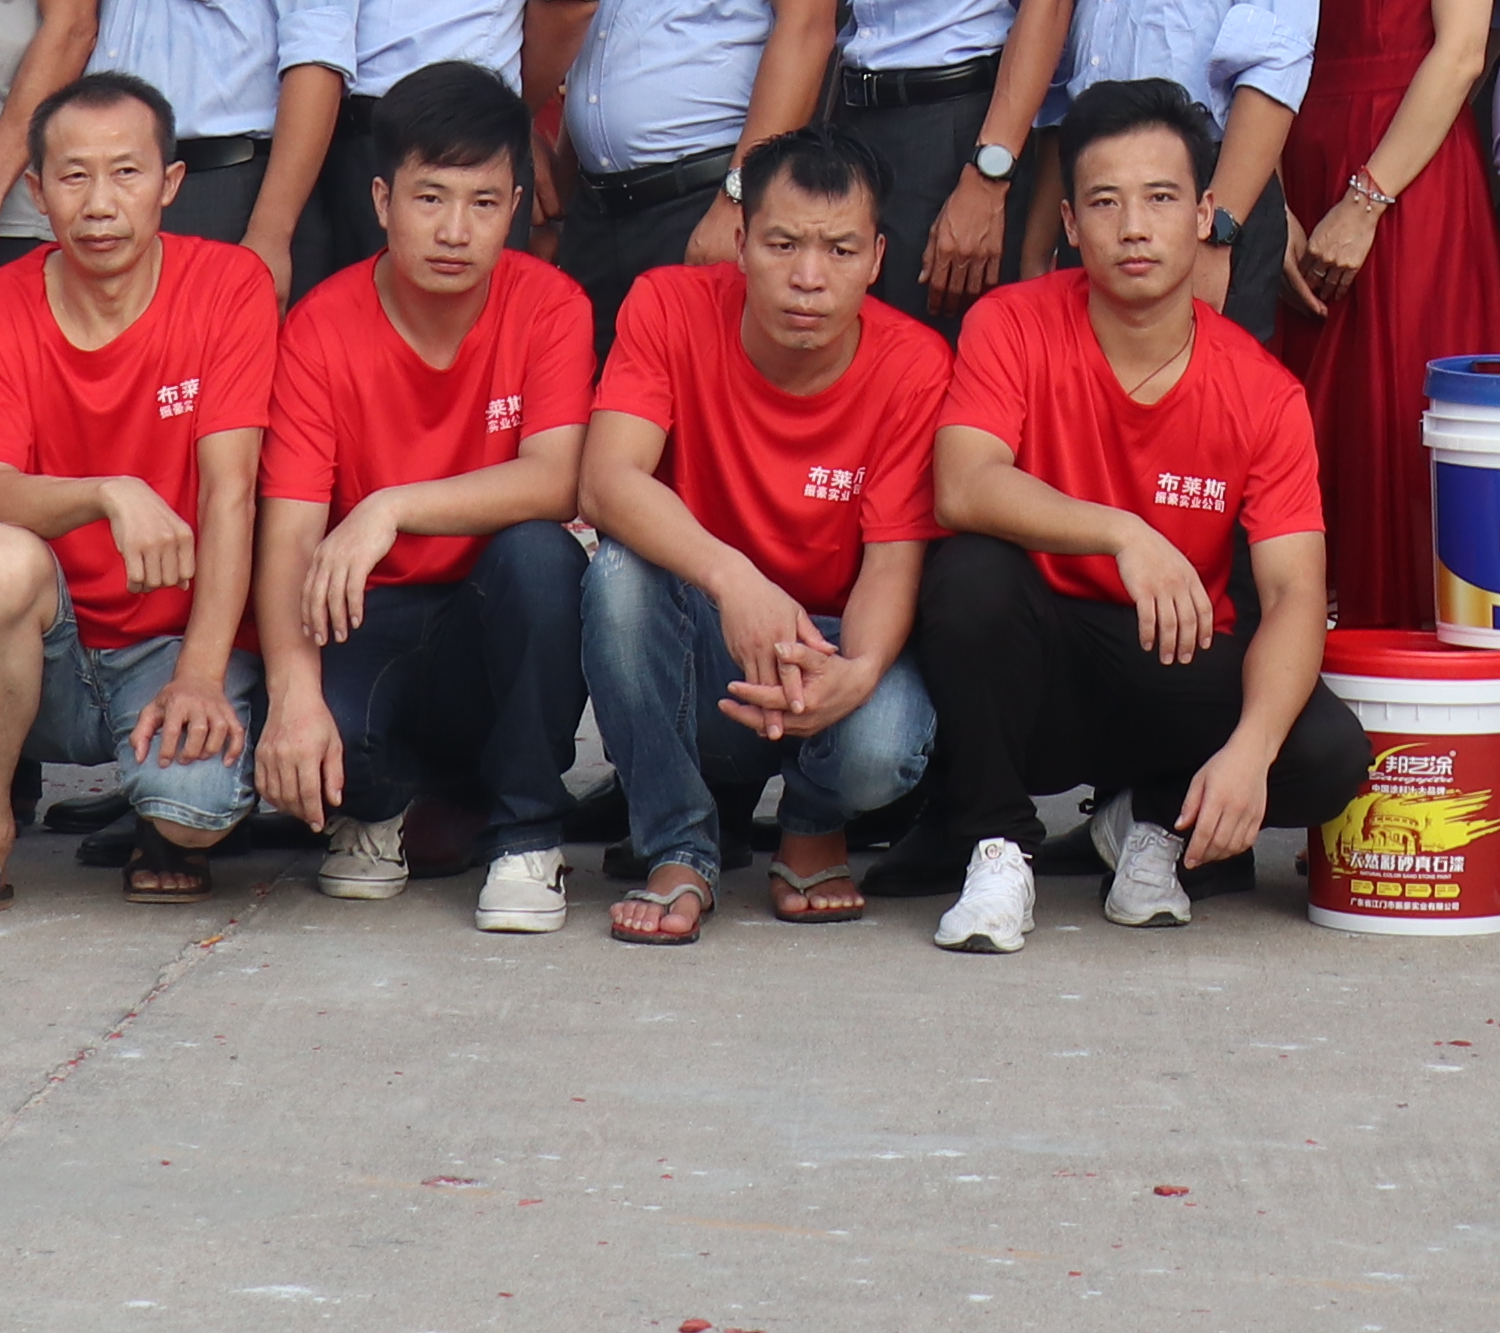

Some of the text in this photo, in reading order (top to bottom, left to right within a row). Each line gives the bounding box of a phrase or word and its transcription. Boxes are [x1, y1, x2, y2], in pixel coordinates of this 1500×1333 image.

[1157, 472, 1227, 500] 布莱斯
[1385, 755, 1453, 775] 邦艺涂
